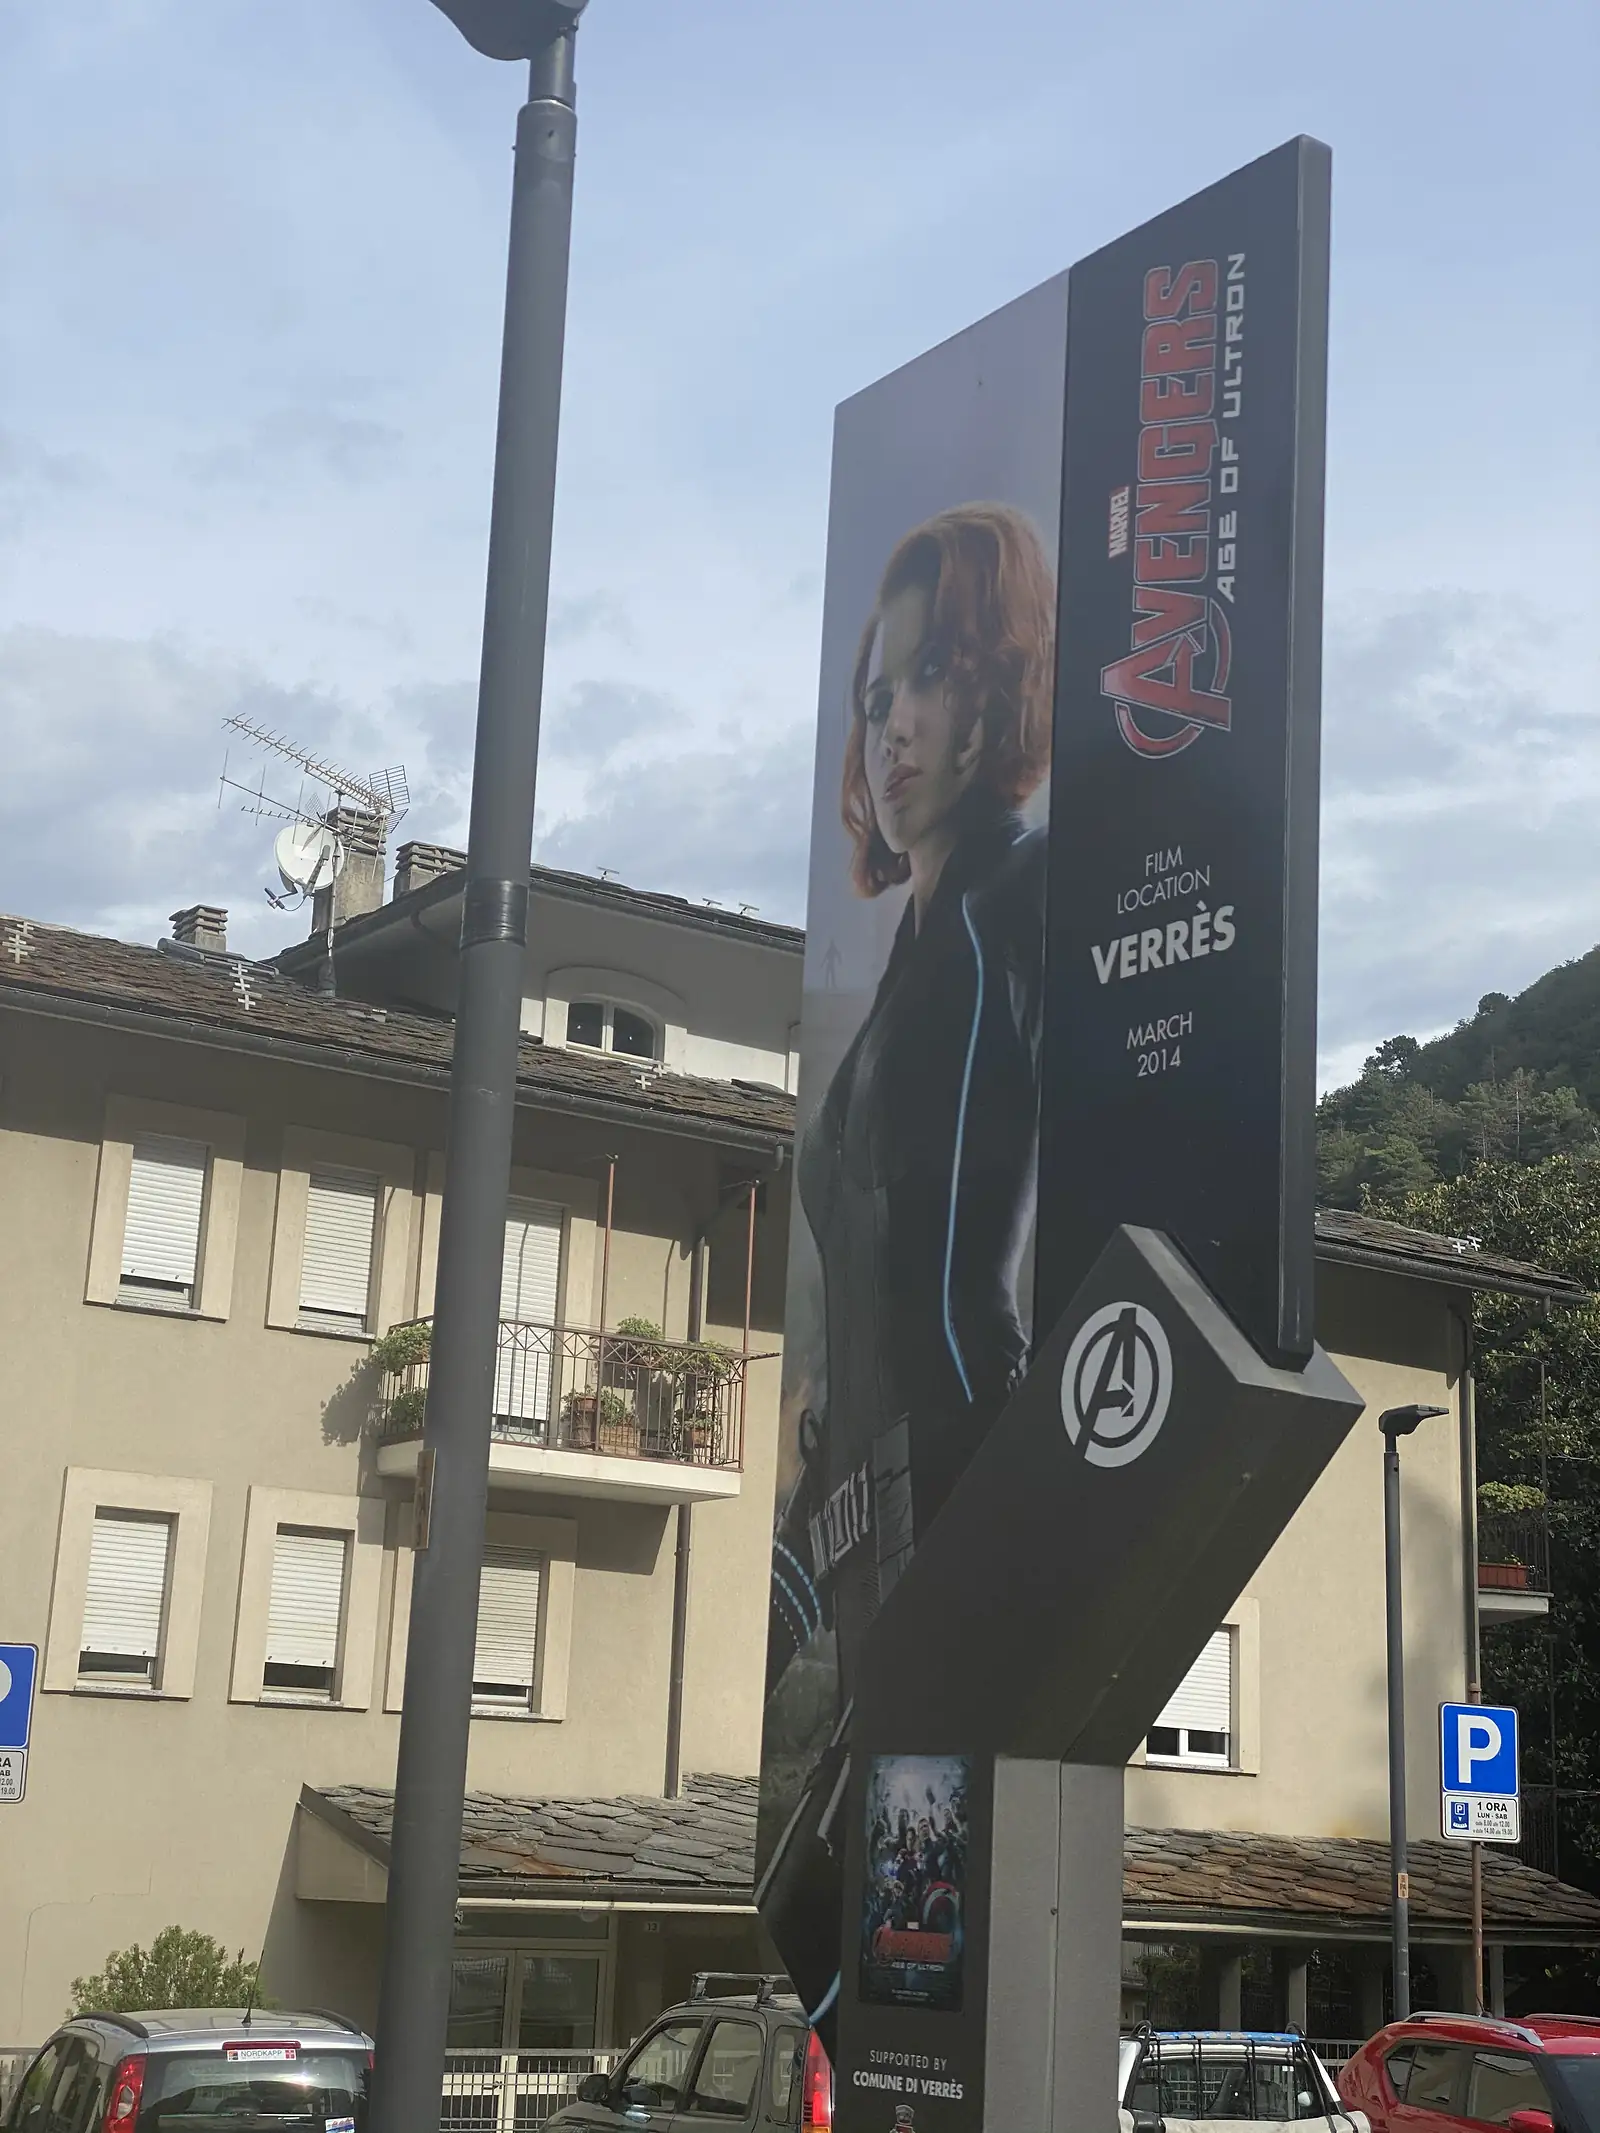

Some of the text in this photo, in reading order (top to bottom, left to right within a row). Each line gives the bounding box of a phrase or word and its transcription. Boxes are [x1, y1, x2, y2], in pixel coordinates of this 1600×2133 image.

[1216, 253, 1246, 603] AGE OF ULTRON
[1100, 258, 1232, 759] AVENGERS
[1108, 486, 1129, 558] MARVEL
[1145, 845, 1183, 876] FILM
[1117, 865, 1210, 914] LOCATION
[1091, 900, 1236, 985] VERRÈS
[1126, 1011, 1193, 1050] MARCH
[1137, 1045, 1182, 1077] 2014
[1457, 1714, 1502, 1784] P
[1477, 1801, 1508, 1812] 1 ORA
[869, 2050, 947, 2071] SUPPORTED BY
[853, 2070, 963, 2100] COMUNE DI VERRÈS
